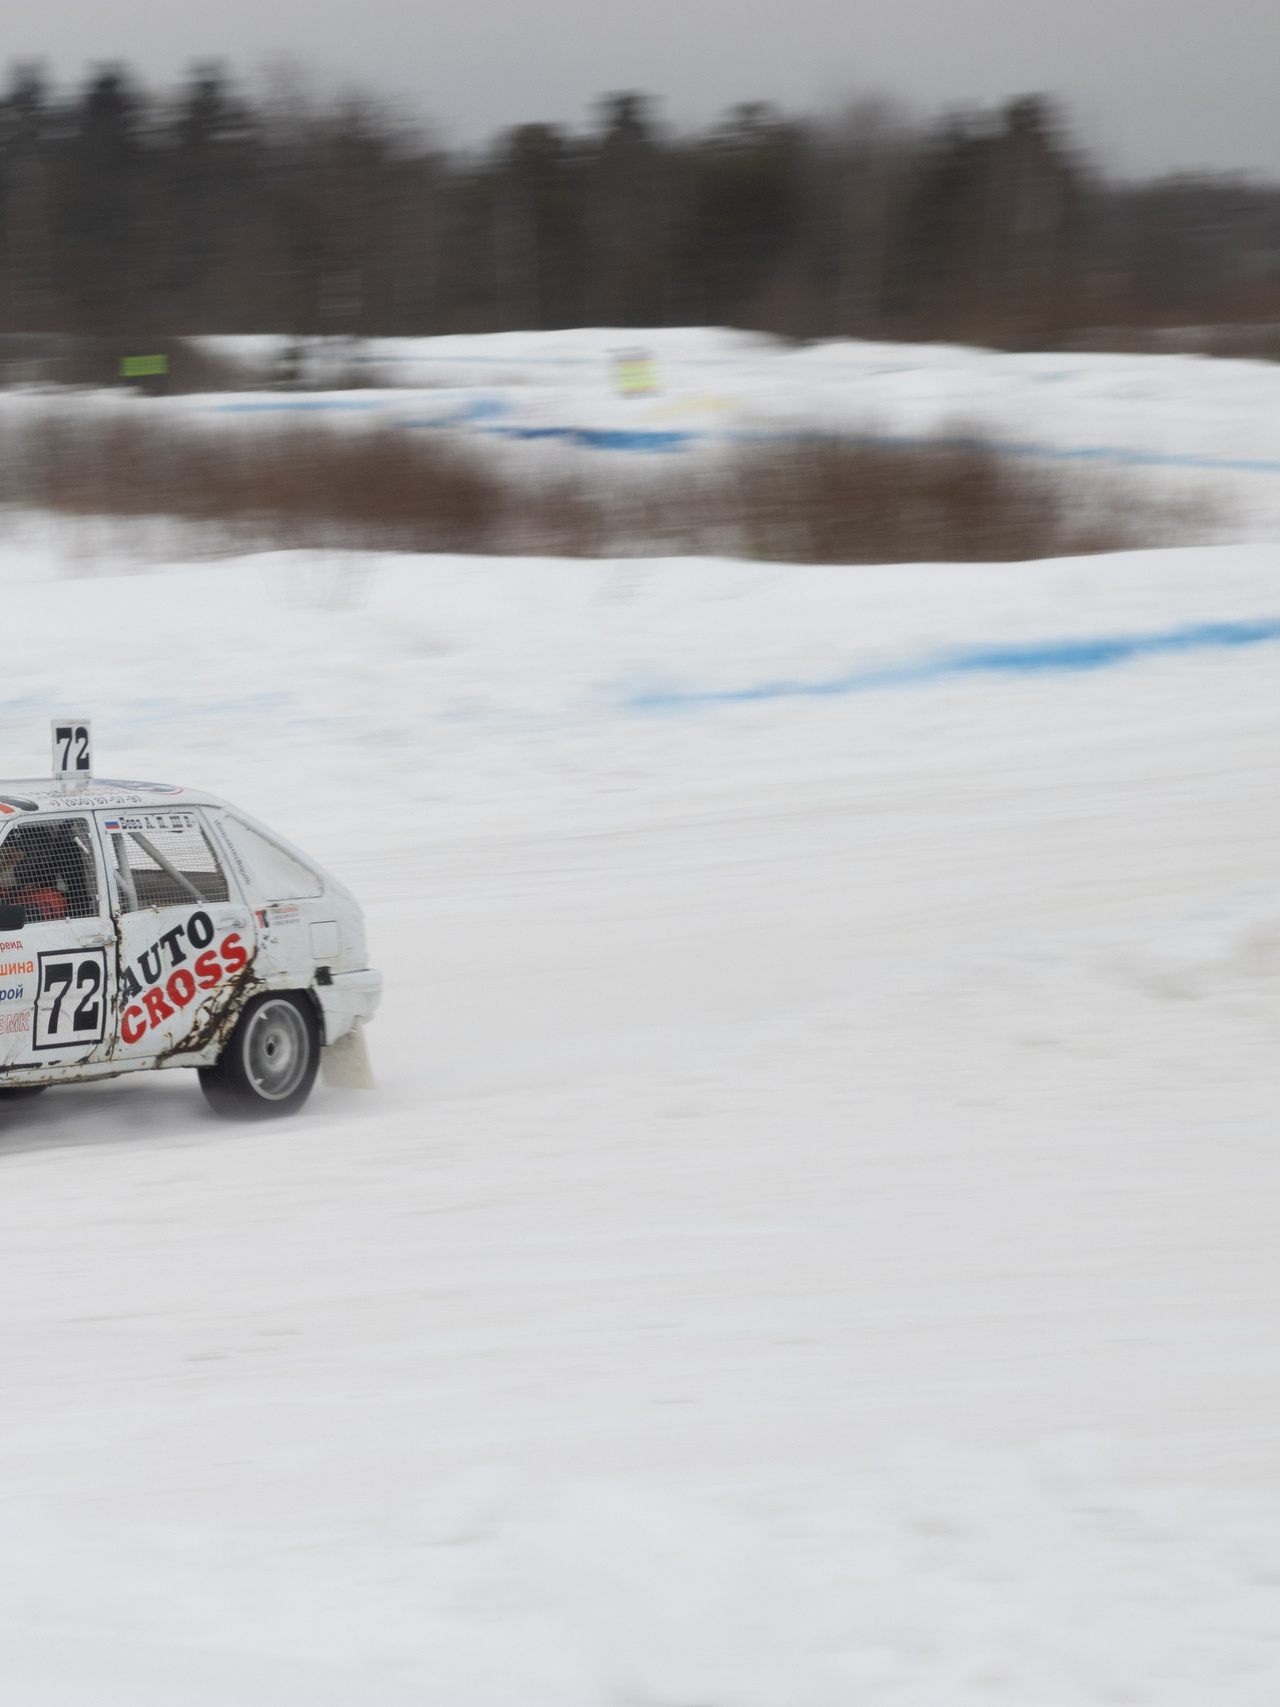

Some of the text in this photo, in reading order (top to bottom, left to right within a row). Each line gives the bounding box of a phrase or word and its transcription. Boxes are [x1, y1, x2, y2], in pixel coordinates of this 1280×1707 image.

[56, 726, 90, 771] 72
[44, 960, 101, 1034] 72
[121, 911, 215, 1004] AUTO
[121, 933, 247, 1044] CROSS
